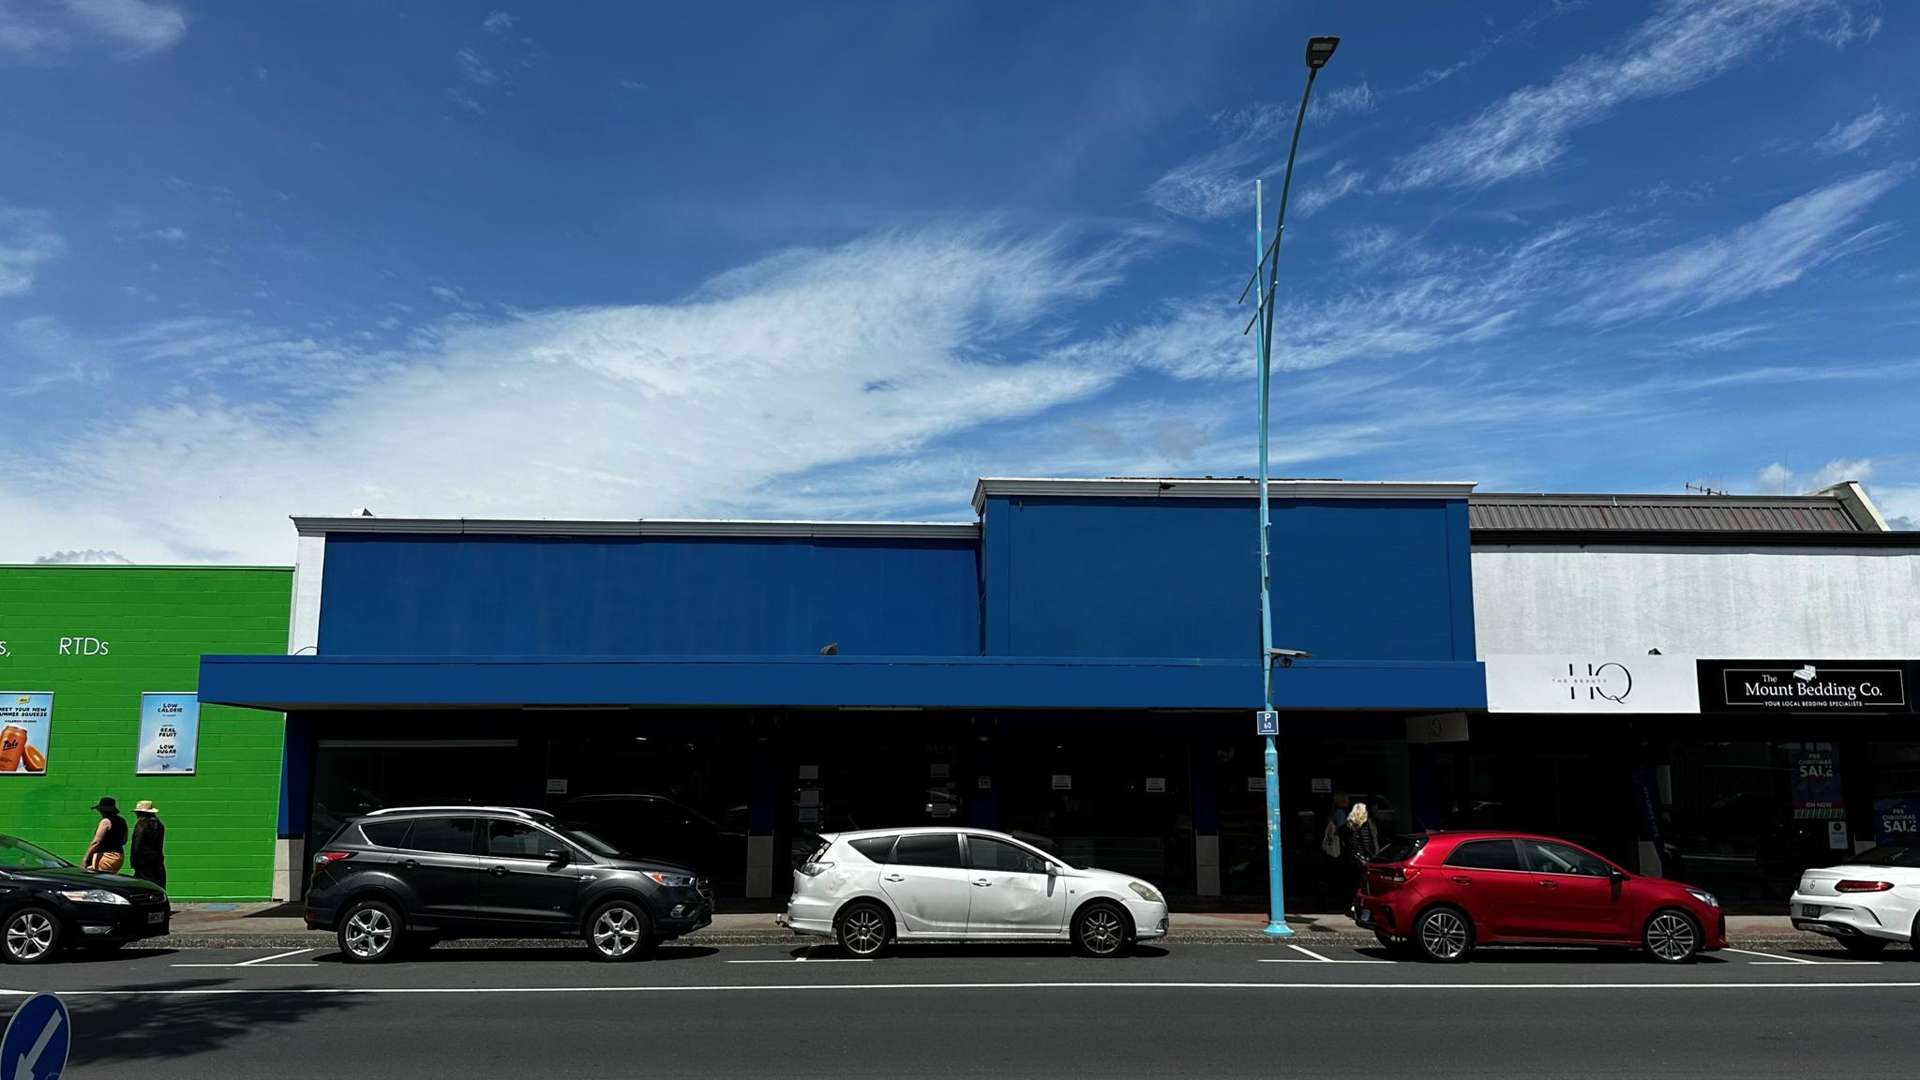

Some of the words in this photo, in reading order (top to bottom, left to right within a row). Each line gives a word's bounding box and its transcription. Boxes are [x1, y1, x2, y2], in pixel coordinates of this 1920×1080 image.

[59, 637, 109, 655] RTDs
[1569, 662, 1632, 705] HQ
[1762, 674, 1778, 682] The
[1744, 682, 1794, 696] Mount
[1797, 682, 1857, 700] Bedding
[1860, 682, 1883, 696] Co.
[1264, 713, 1272, 721] P
[1800, 765, 1834, 778] SALE
[1883, 820, 1918, 833] SALE
